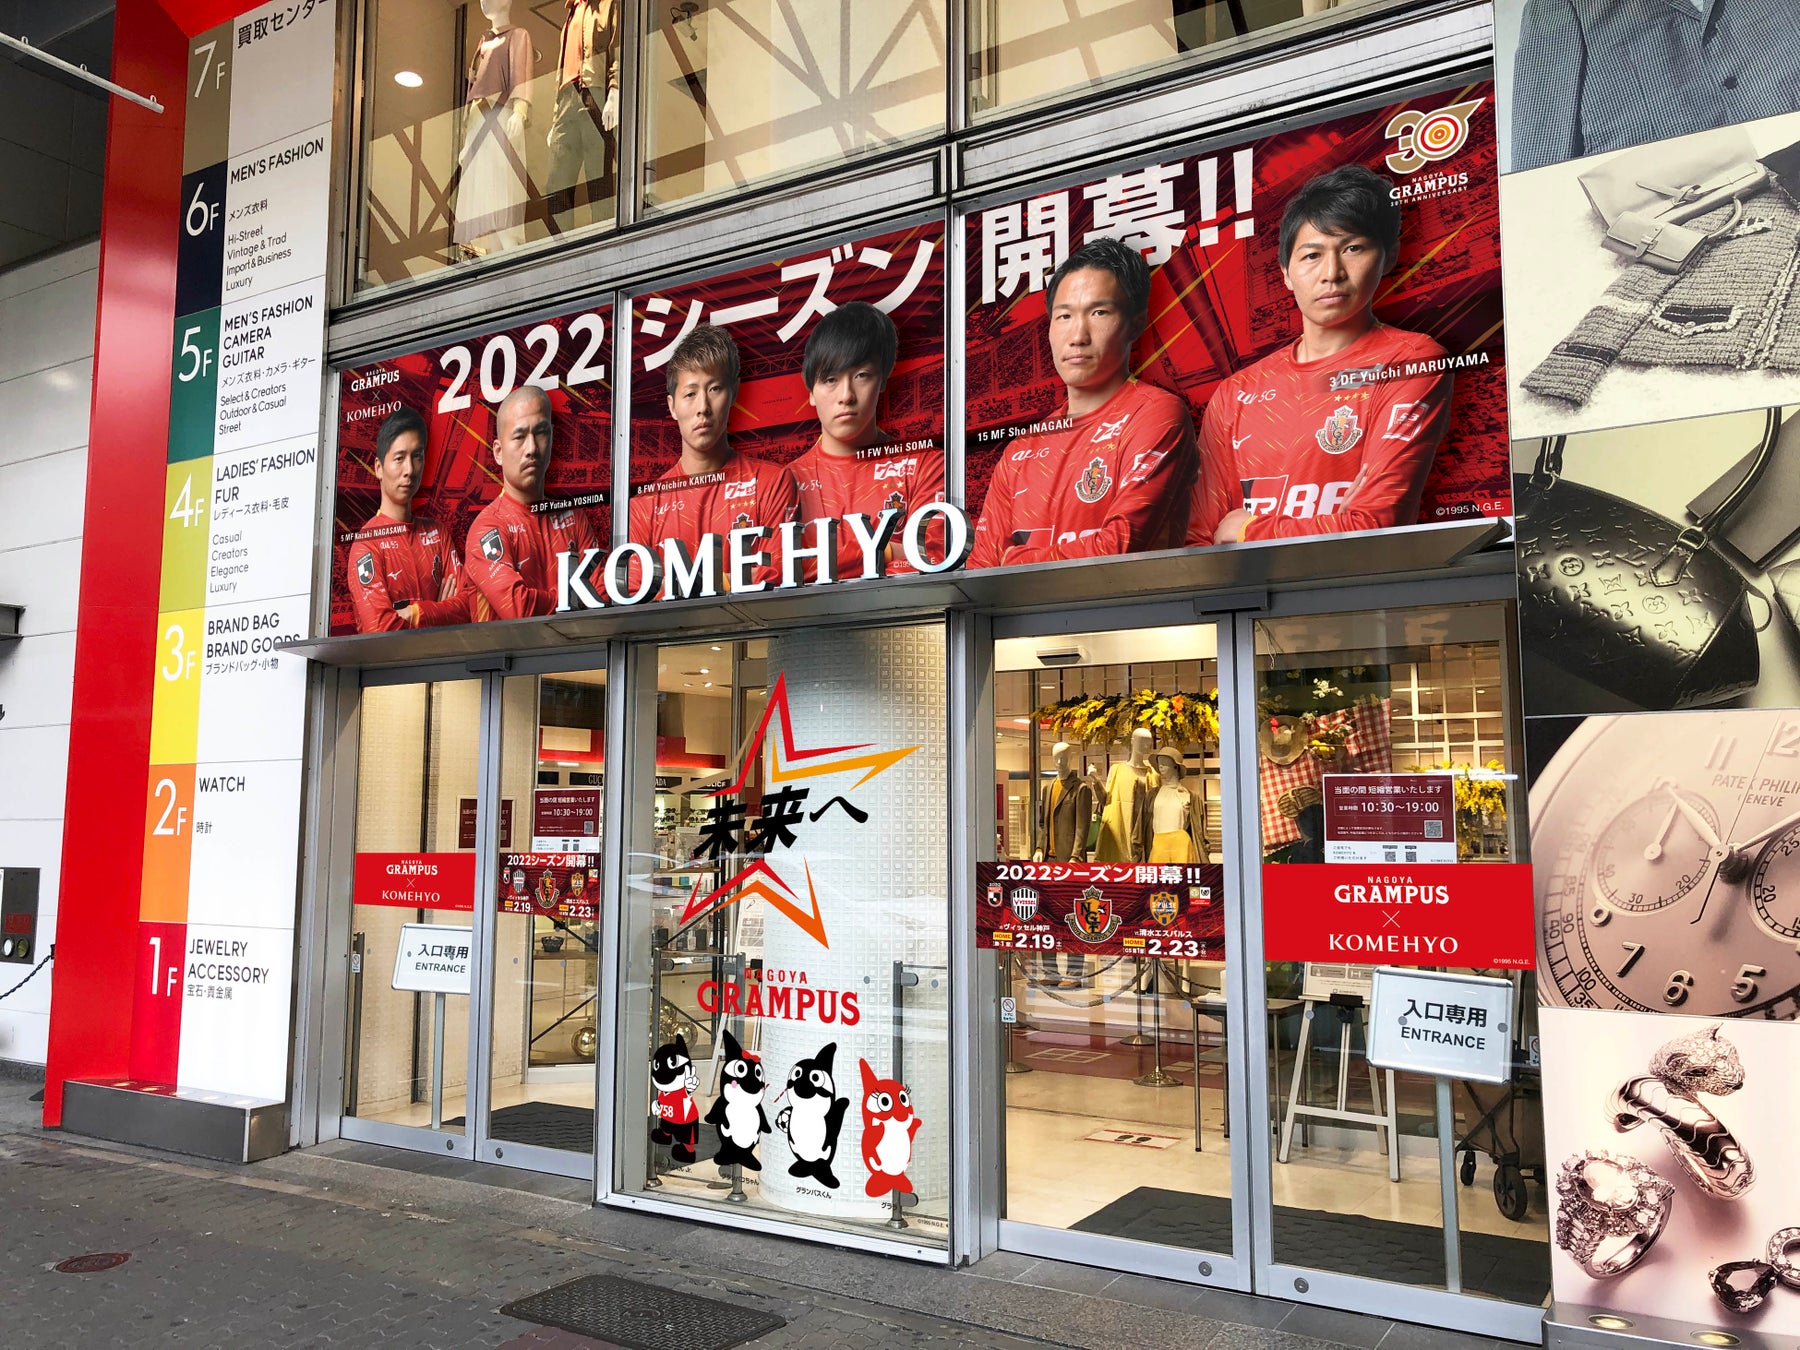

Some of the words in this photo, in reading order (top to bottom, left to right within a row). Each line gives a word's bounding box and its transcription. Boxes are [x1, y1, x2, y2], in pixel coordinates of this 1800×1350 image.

[268, 137, 324, 171] FASHION
[1389, 172, 1469, 200] GRAMPUS
[1411, 171, 1444, 184] NAGOYA
[1411, 185, 1469, 203] ANNIVERSARY
[228, 199, 269, 222] メンズ衣料
[228, 224, 264, 246] Hi-Street
[227, 243, 259, 260] Vintage
[260, 239, 266, 250] &
[267, 232, 287, 248] Trad
[226, 259, 250, 276] Import
[250, 257, 257, 269] &
[257, 248, 292, 267] Business
[225, 276, 253, 291] Luxury
[261, 295, 313, 323] FASHION
[437, 312, 605, 415] 2022
[640, 235, 936, 373] シーズン
[223, 326, 272, 350] CAMERA
[222, 346, 265, 369] GUITAR
[1329, 376, 1337, 388] 3
[1340, 372, 1356, 386] DF
[1360, 365, 1401, 382] Yuichi
[1405, 351, 1490, 376] MARUYAMA
[351, 369, 400, 392] GRAMPUS
[220, 391, 243, 407] Select
[244, 390, 250, 401] &
[251, 383, 287, 400] Creators
[219, 406, 251, 421] Outdoor
[251, 402, 258, 414] &
[258, 395, 287, 412] Casual
[346, 400, 402, 423] KOMEHYO
[218, 421, 242, 436] Street
[977, 431, 989, 442] 15
[990, 428, 1006, 440] MF
[1008, 425, 1027, 437] Sho
[1029, 417, 1074, 433] INAGAKI
[855, 450, 866, 460] 11
[867, 447, 882, 459] FW
[883, 443, 903, 454] Yuki
[905, 438, 934, 451] SOMA
[260, 447, 316, 473] FASHION
[643, 484, 656, 494] FW
[656, 480, 688, 491] Yoichiro
[688, 472, 726, 486] KAKITANI
[214, 486, 240, 505] FUR
[530, 504, 539, 513] 23
[539, 502, 549, 511] DF
[550, 500, 572, 510] Yutaka
[573, 493, 605, 507] YOSHIDA
[1471, 501, 1505, 513] N.G.E.
[212, 530, 243, 546] Casual
[345, 532, 354, 542] MF
[354, 529, 373, 540] Kazuki
[373, 524, 407, 537] NAGASAWA
[211, 547, 249, 562] Creators
[555, 502, 972, 613] KOMEHYO
[210, 563, 249, 579] Elegance
[209, 581, 238, 594] Luxury
[207, 617, 250, 636] BRAND
[252, 612, 280, 630] BAG
[206, 639, 249, 659] BRAND
[199, 776, 246, 793] WATCH
[1737, 793, 1786, 807] ENEVE
[196, 821, 213, 834] 時計
[693, 785, 869, 861] 未来へ
[1780, 839, 1800, 857] 25
[386, 864, 439, 876] GRAMPUS
[1367, 875, 1413, 885] NAGOYA
[1675, 874, 1692, 890] 20
[382, 890, 441, 904] KOMEHYO
[1334, 884, 1450, 905] GRAMPUS
[1628, 892, 1644, 905] 30
[1762, 884, 1777, 903] 20
[513, 901, 531, 913] 2.19
[568, 905, 592, 918] 2.23
[1549, 920, 1561, 939] 40
[1562, 912, 1575, 935] 90
[189, 938, 249, 958] JEWELRY
[1015, 932, 1055, 950] 2.19
[1148, 938, 1199, 957] 2.23
[1328, 933, 1459, 954] KOMEHYO
[417, 943, 469, 961] 入口専用
[1616, 940, 1647, 978] 7
[187, 963, 270, 984] ACCESSORY
[415, 961, 467, 974] ENTRANCE
[743, 967, 808, 985] NAGOYA
[1576, 966, 1597, 991] 100
[1662, 969, 1695, 1007] 6
[1730, 963, 1767, 1003] 5
[696, 980, 861, 1027] GRAMPUS
[1402, 998, 1488, 1029] 入口専用
[1400, 1026, 1486, 1051] ENTRANCE
[795, 1186, 833, 1199] グランパスくん
